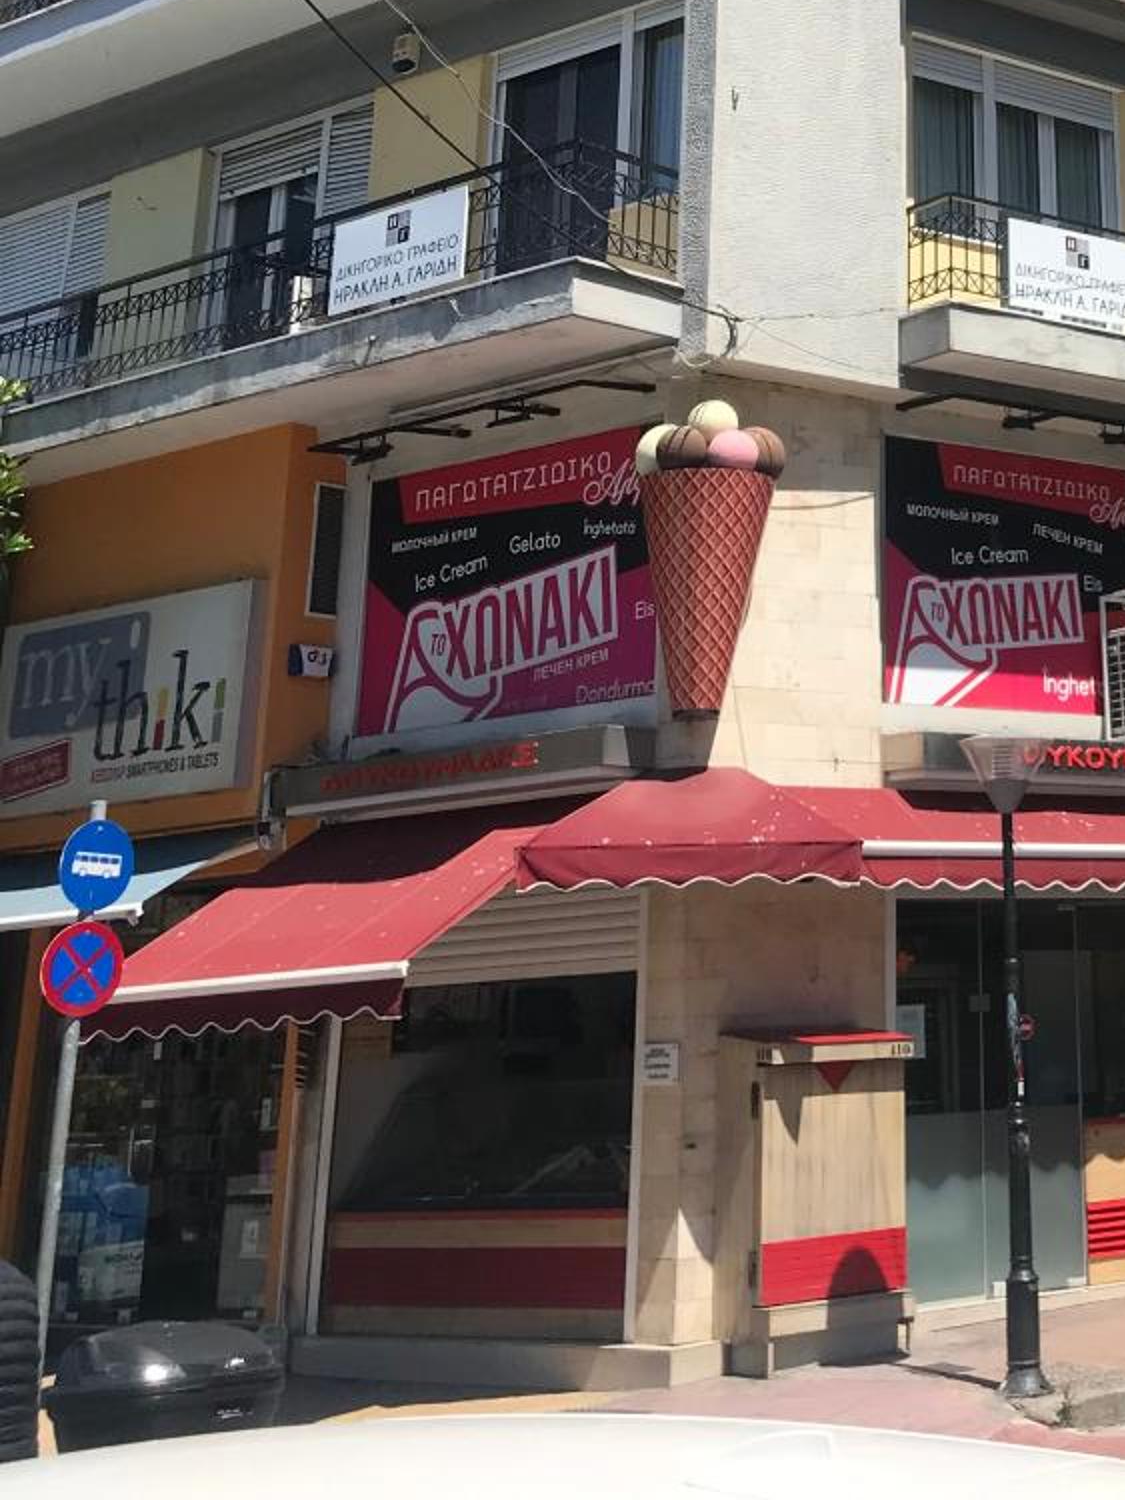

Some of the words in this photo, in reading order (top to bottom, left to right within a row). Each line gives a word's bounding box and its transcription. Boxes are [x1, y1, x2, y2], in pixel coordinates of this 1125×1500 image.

[335, 251, 403, 282] ΔΙΚΗΓΟΡΙΚΟ
[407, 234, 459, 260] ΓΡΑΦΕΙΟ
[334, 274, 388, 305] ΗΡΑΚΛΗ
[407, 255, 457, 285] ΓΑΡΙΔΗ
[1016, 284, 1073, 308] ΗΡΑΚΛΗ
[415, 451, 611, 512] ΠΑΓΩΤΑΤΖΙΔΙΚΟ
[953, 465, 1110, 501] ΠΑΓΩΤΑΤΖΙΔΙΚΟ
[971, 510, 999, 527] КРЕМ
[509, 531, 561, 555] Gelato
[951, 547, 974, 565] Ice
[979, 545, 1029, 565] Cream
[1073, 535, 1103, 555] КРЕМ
[415, 573, 434, 593] Ice
[439, 556, 488, 582] Cream
[431, 633, 447, 657] ΤΟ
[443, 555, 612, 680] ΧΩΝΑΚΙ
[635, 600, 656, 620] Eis
[931, 601, 945, 623] ΤΟ
[942, 578, 1081, 645] ΧΩΝΑΚΙ
[575, 649, 608, 670] КРЕМ
